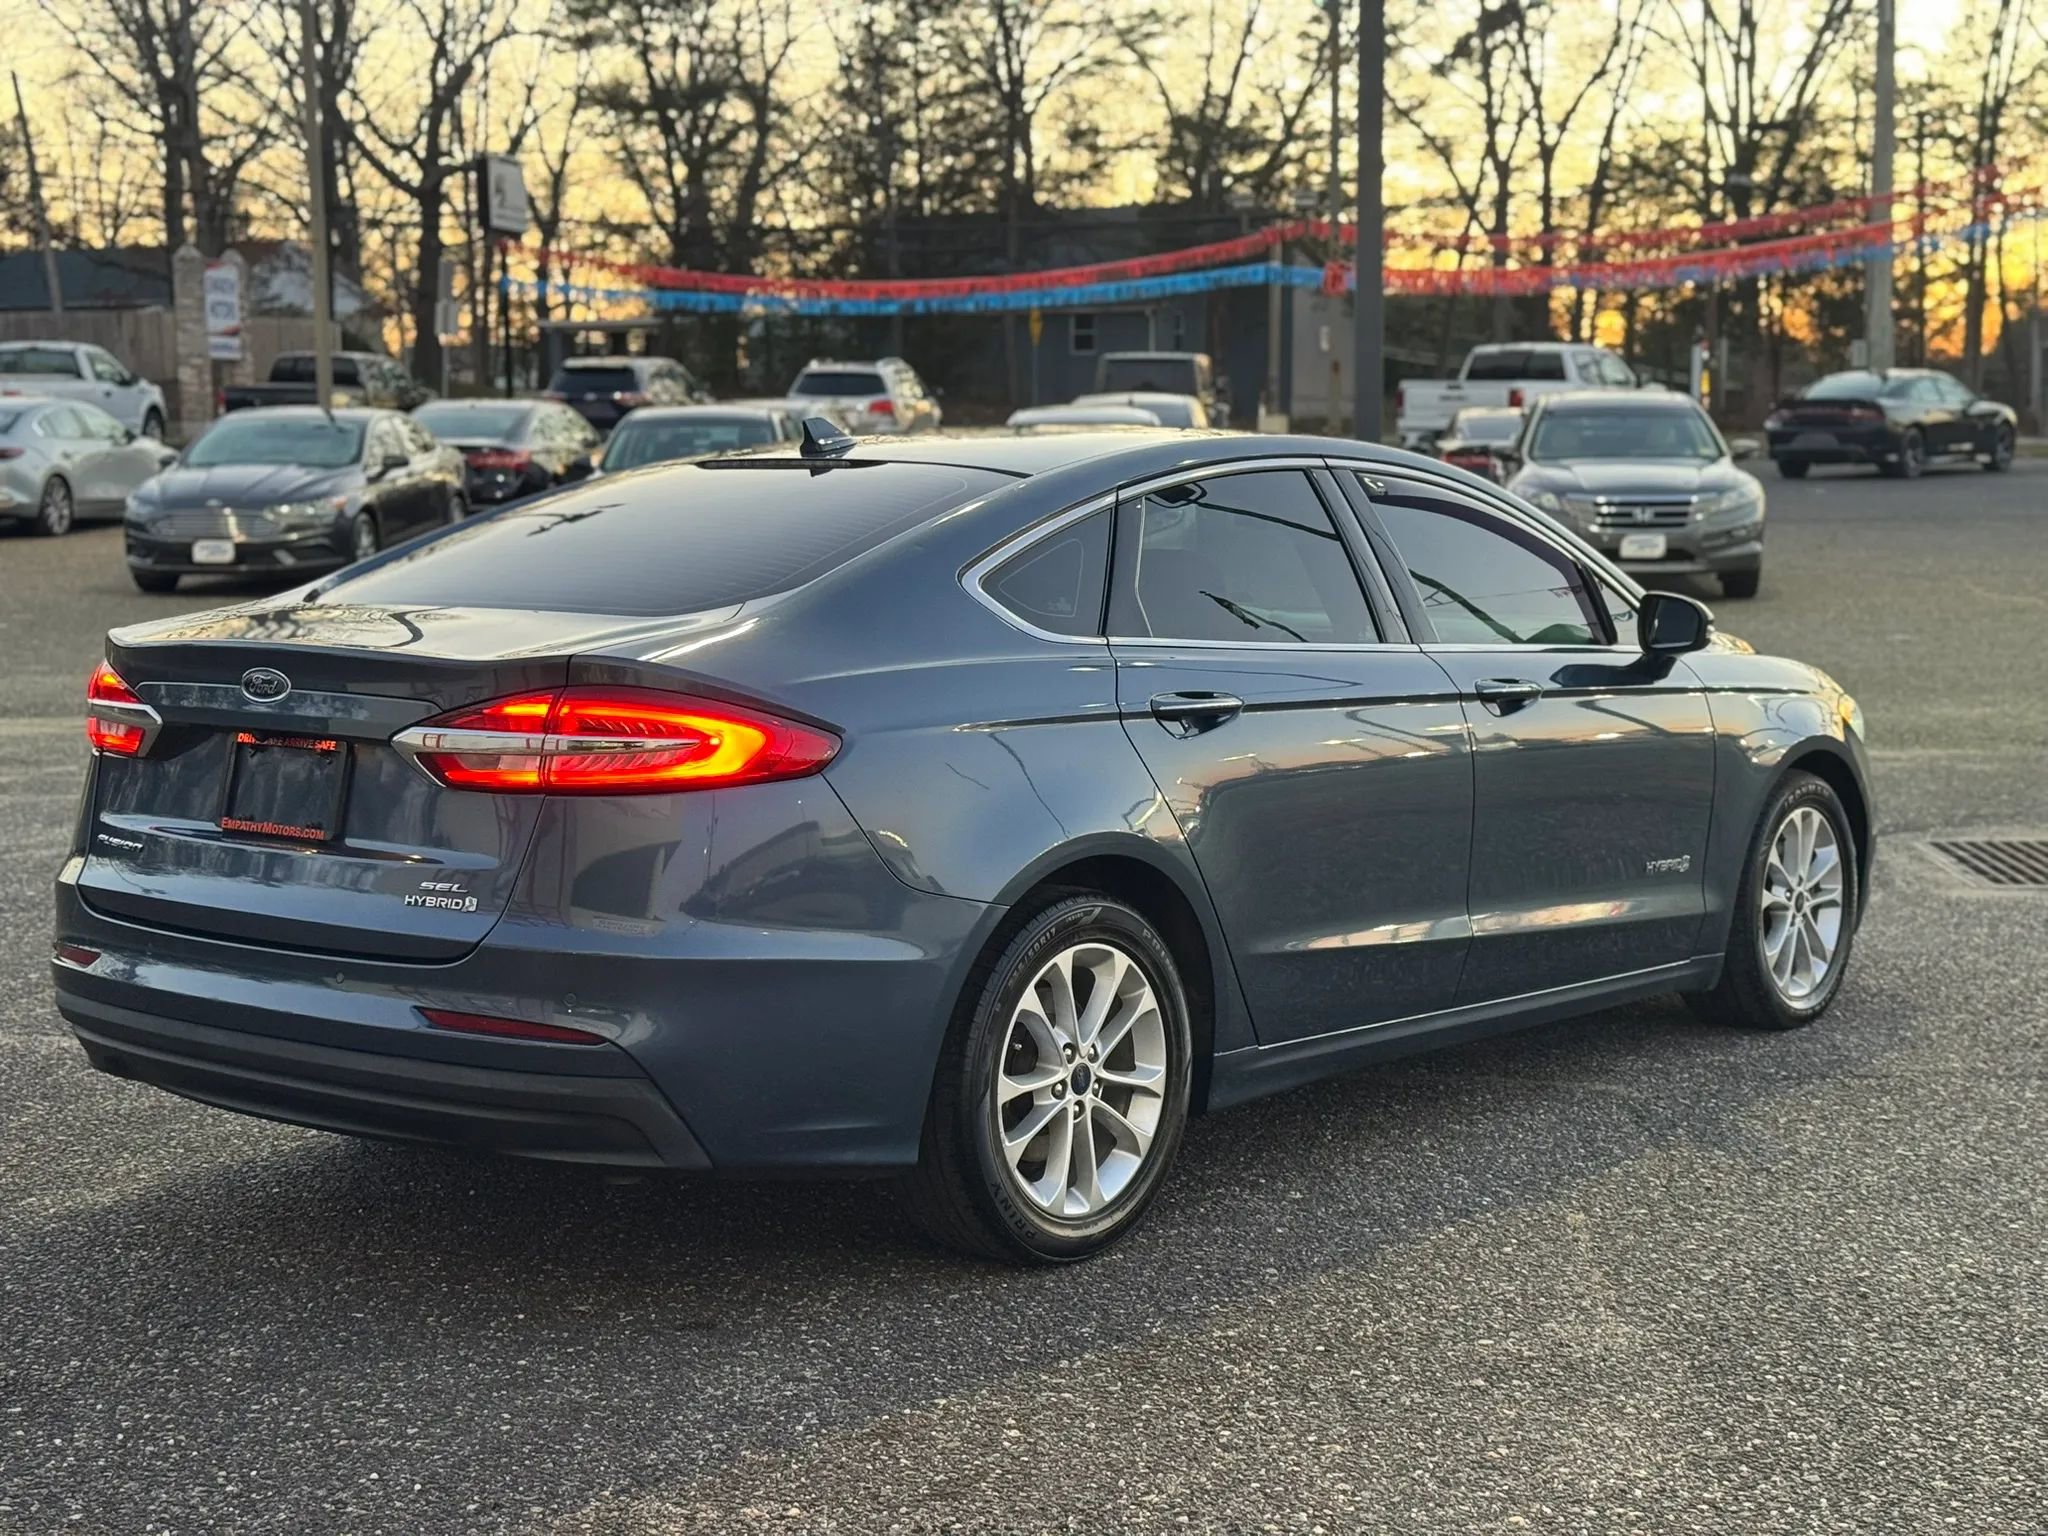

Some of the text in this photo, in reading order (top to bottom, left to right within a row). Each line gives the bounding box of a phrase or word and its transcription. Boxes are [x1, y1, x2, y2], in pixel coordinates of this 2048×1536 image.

[249, 674, 278, 694] Ford
[314, 740, 337, 751] SAFE
[418, 881, 469, 893] SEL
[404, 894, 463, 910] HYBRID
